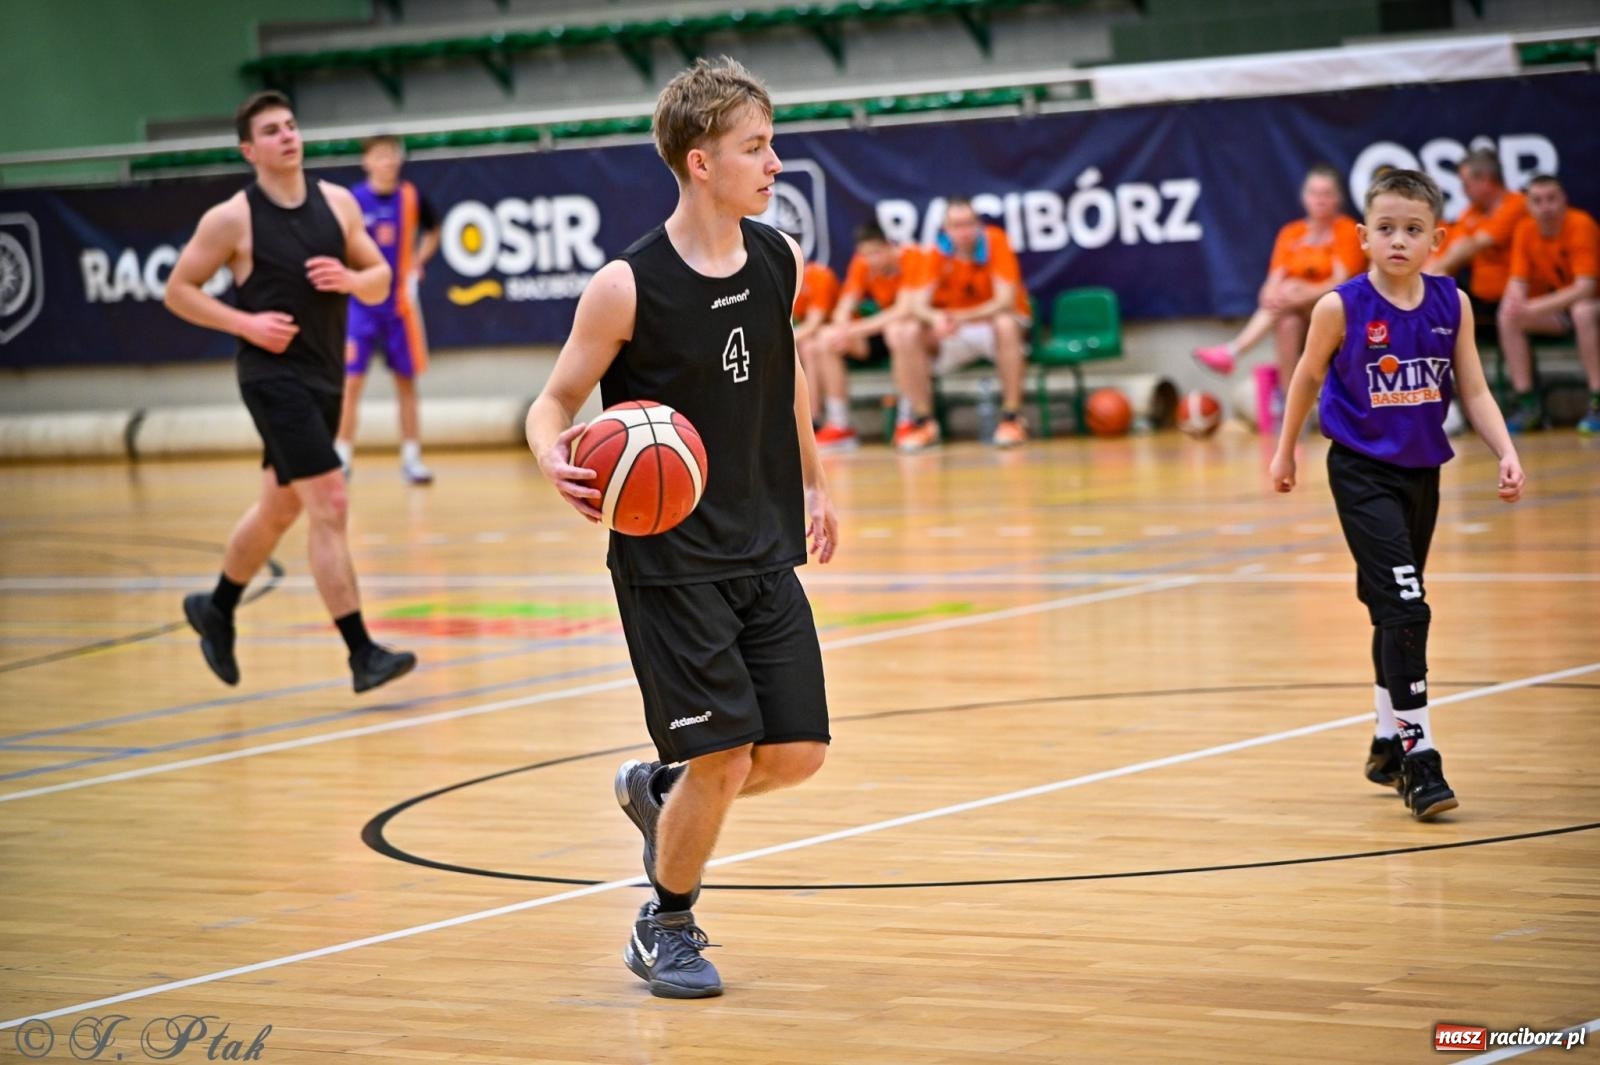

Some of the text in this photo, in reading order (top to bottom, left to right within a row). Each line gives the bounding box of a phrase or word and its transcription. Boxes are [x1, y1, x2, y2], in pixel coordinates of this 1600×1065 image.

[1350, 133, 1559, 223] OSR
[722, 326, 750, 383] 4
[1392, 565, 1422, 600] 5
